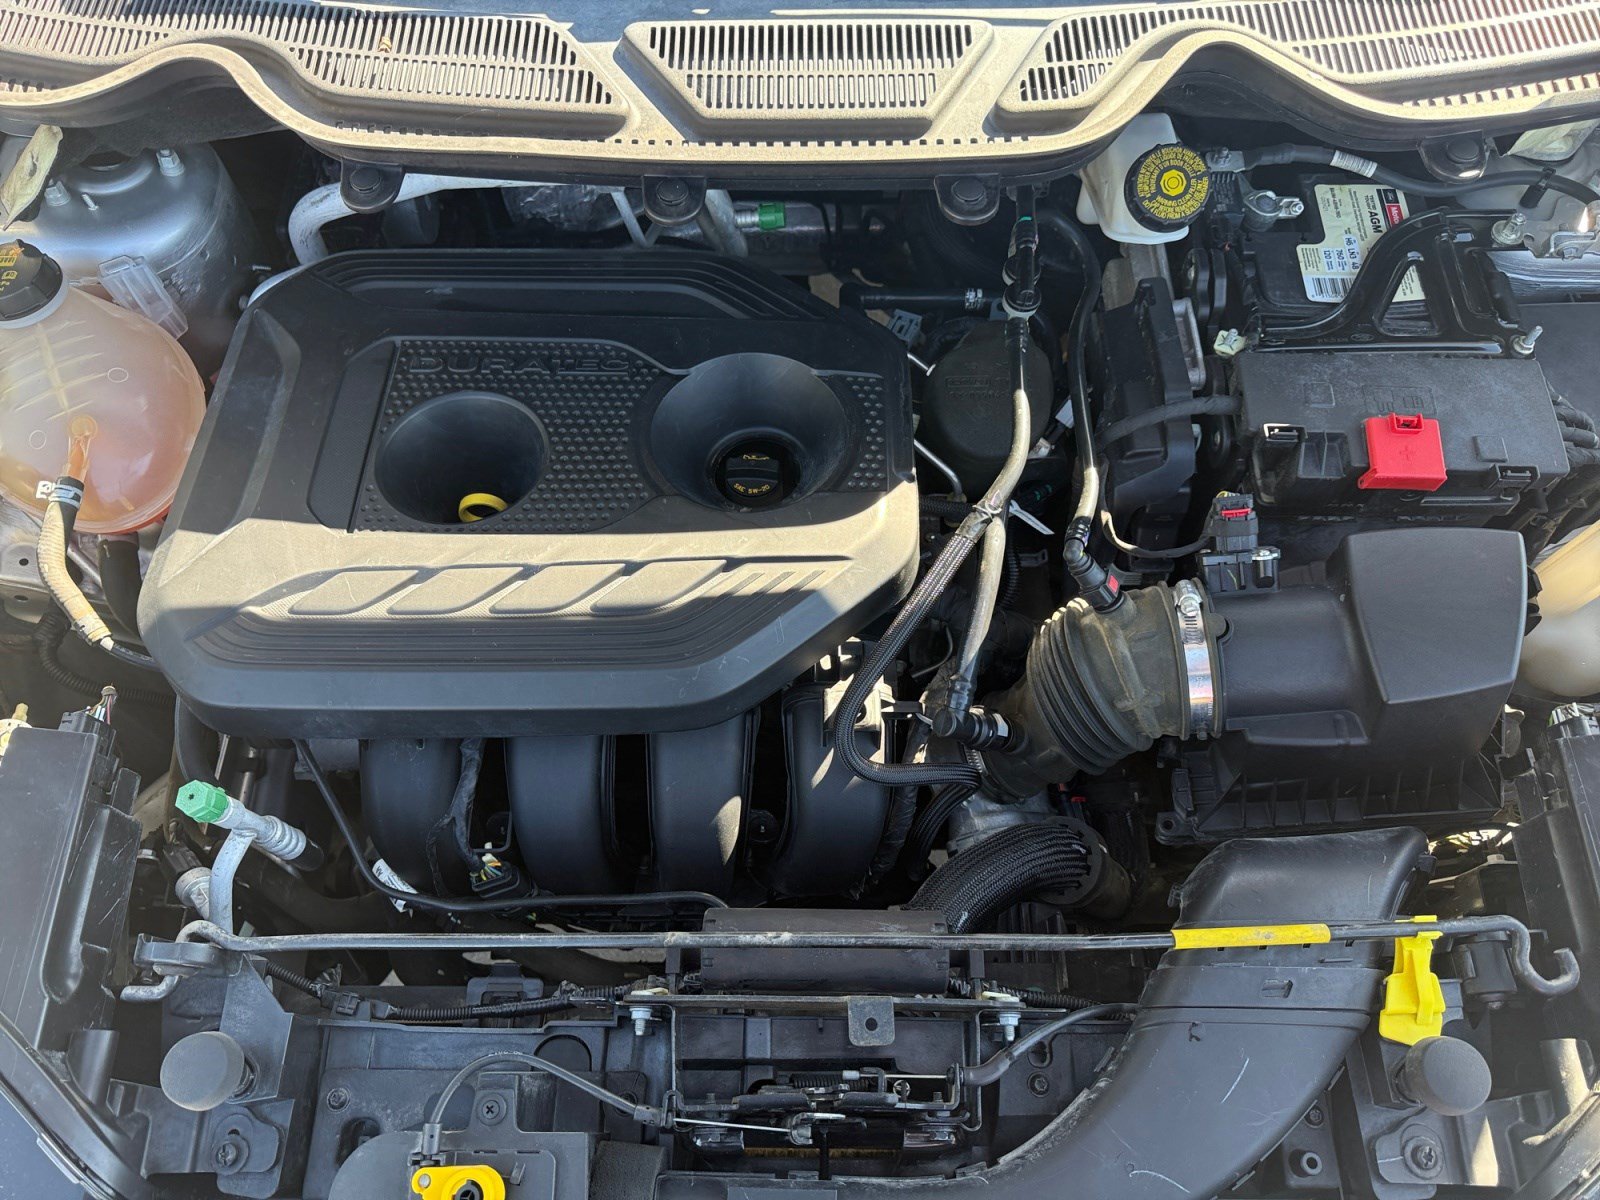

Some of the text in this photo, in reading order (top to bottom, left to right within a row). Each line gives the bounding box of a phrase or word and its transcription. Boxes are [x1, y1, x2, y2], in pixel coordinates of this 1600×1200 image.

[1143, 199, 1153, 209] DOT
[1153, 208, 1167, 218] FLUID
[1185, 201, 1202, 217] SEALED
[1198, 176, 1209, 204] CONTAINER
[1155, 178, 1197, 207] WARNING CLEAN FILLER
[1151, 199, 1160, 208] CAP
[1158, 204, 1174, 213] BEFORE
[1368, 211, 1383, 233] AGM
[1391, 206, 1400, 224] Moto
[1345, 238, 1353, 246] H6
[1348, 249, 1357, 259] LN3
[1351, 262, 1360, 270] 48
[409, 357, 630, 375] DURATEC
[733, 483, 770, 494] SAE 5W-20
